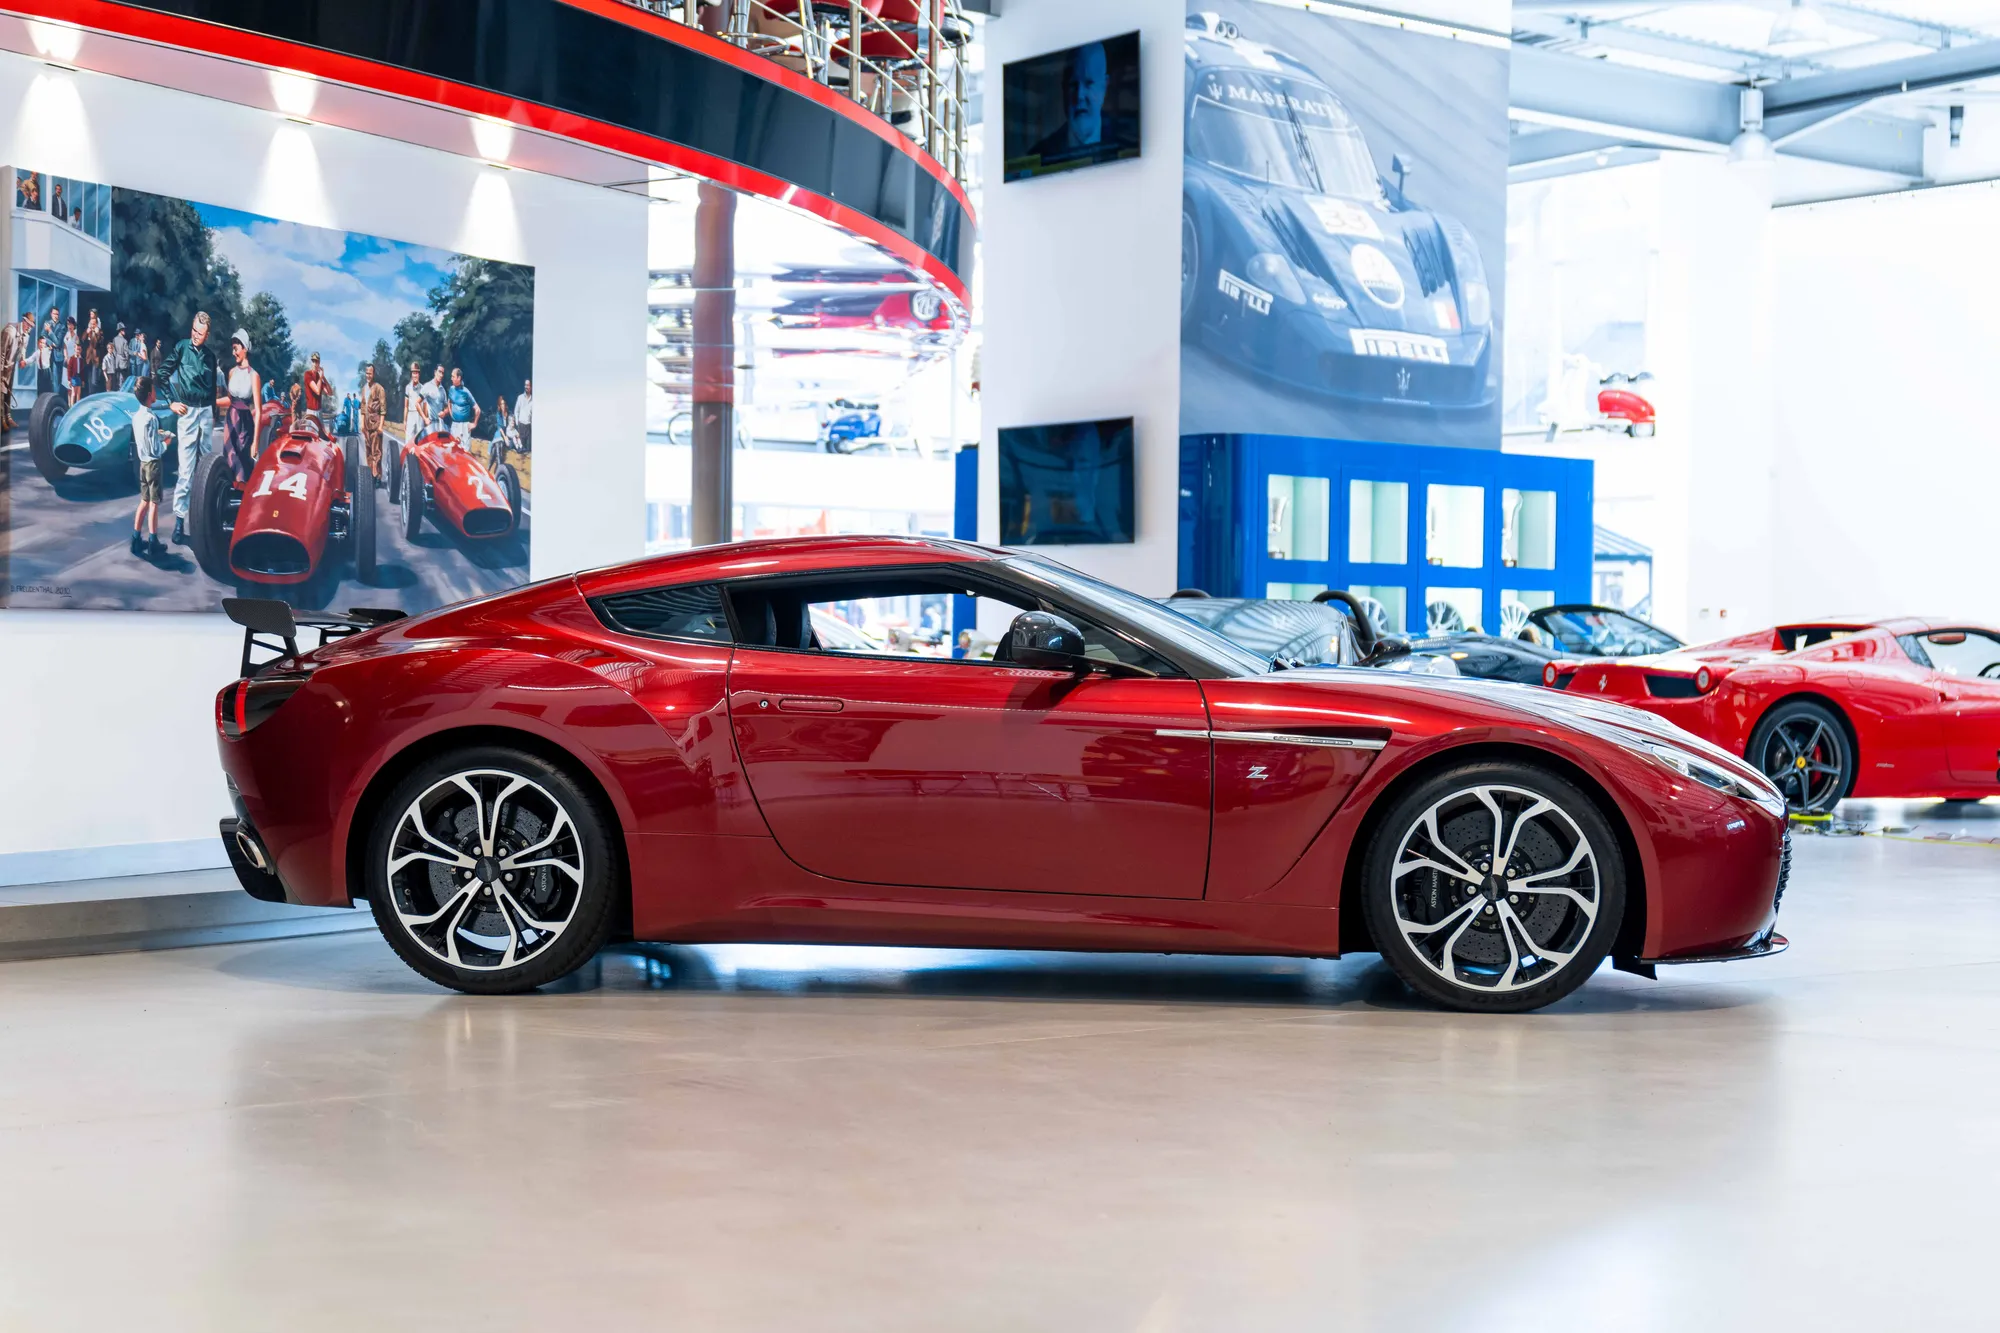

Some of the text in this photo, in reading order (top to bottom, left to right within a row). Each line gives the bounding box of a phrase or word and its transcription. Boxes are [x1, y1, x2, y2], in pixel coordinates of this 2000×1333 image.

[1228, 84, 1335, 119] MASERATI
[1323, 209, 1368, 231] 33
[1218, 268, 1274, 316] PIRLLI
[1349, 328, 1450, 364] PIRELLI
[83, 416, 113, 443] 18
[252, 470, 307, 500] 14
[467, 475, 492, 500] 2
[1246, 765, 1269, 780] Z
